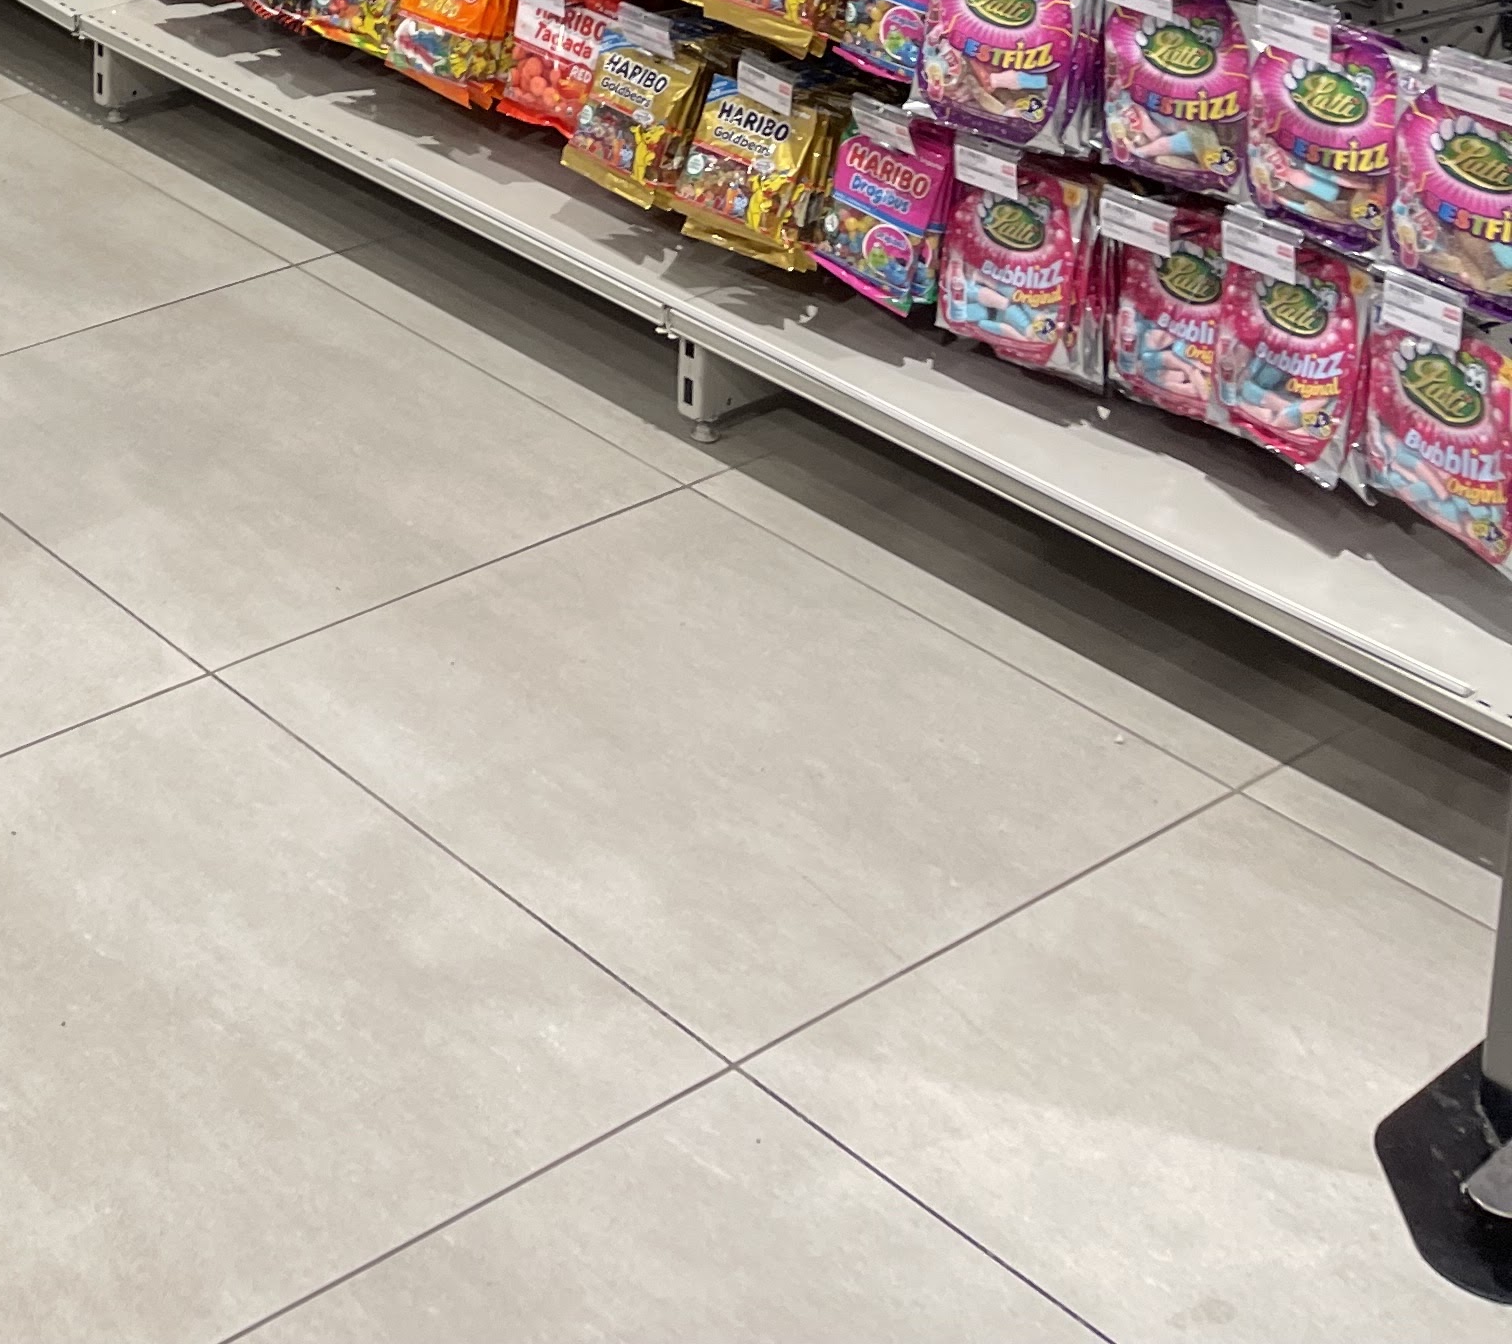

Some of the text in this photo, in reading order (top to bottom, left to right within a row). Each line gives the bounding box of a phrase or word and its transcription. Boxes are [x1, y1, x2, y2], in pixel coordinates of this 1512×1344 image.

[605, 52, 670, 95] HARIBO
[716, 99, 790, 143] HARIBO
[845, 142, 933, 200] HARIBO
[1156, 312, 1216, 346] Bubbli
[1185, 344, 1215, 365] Orig
